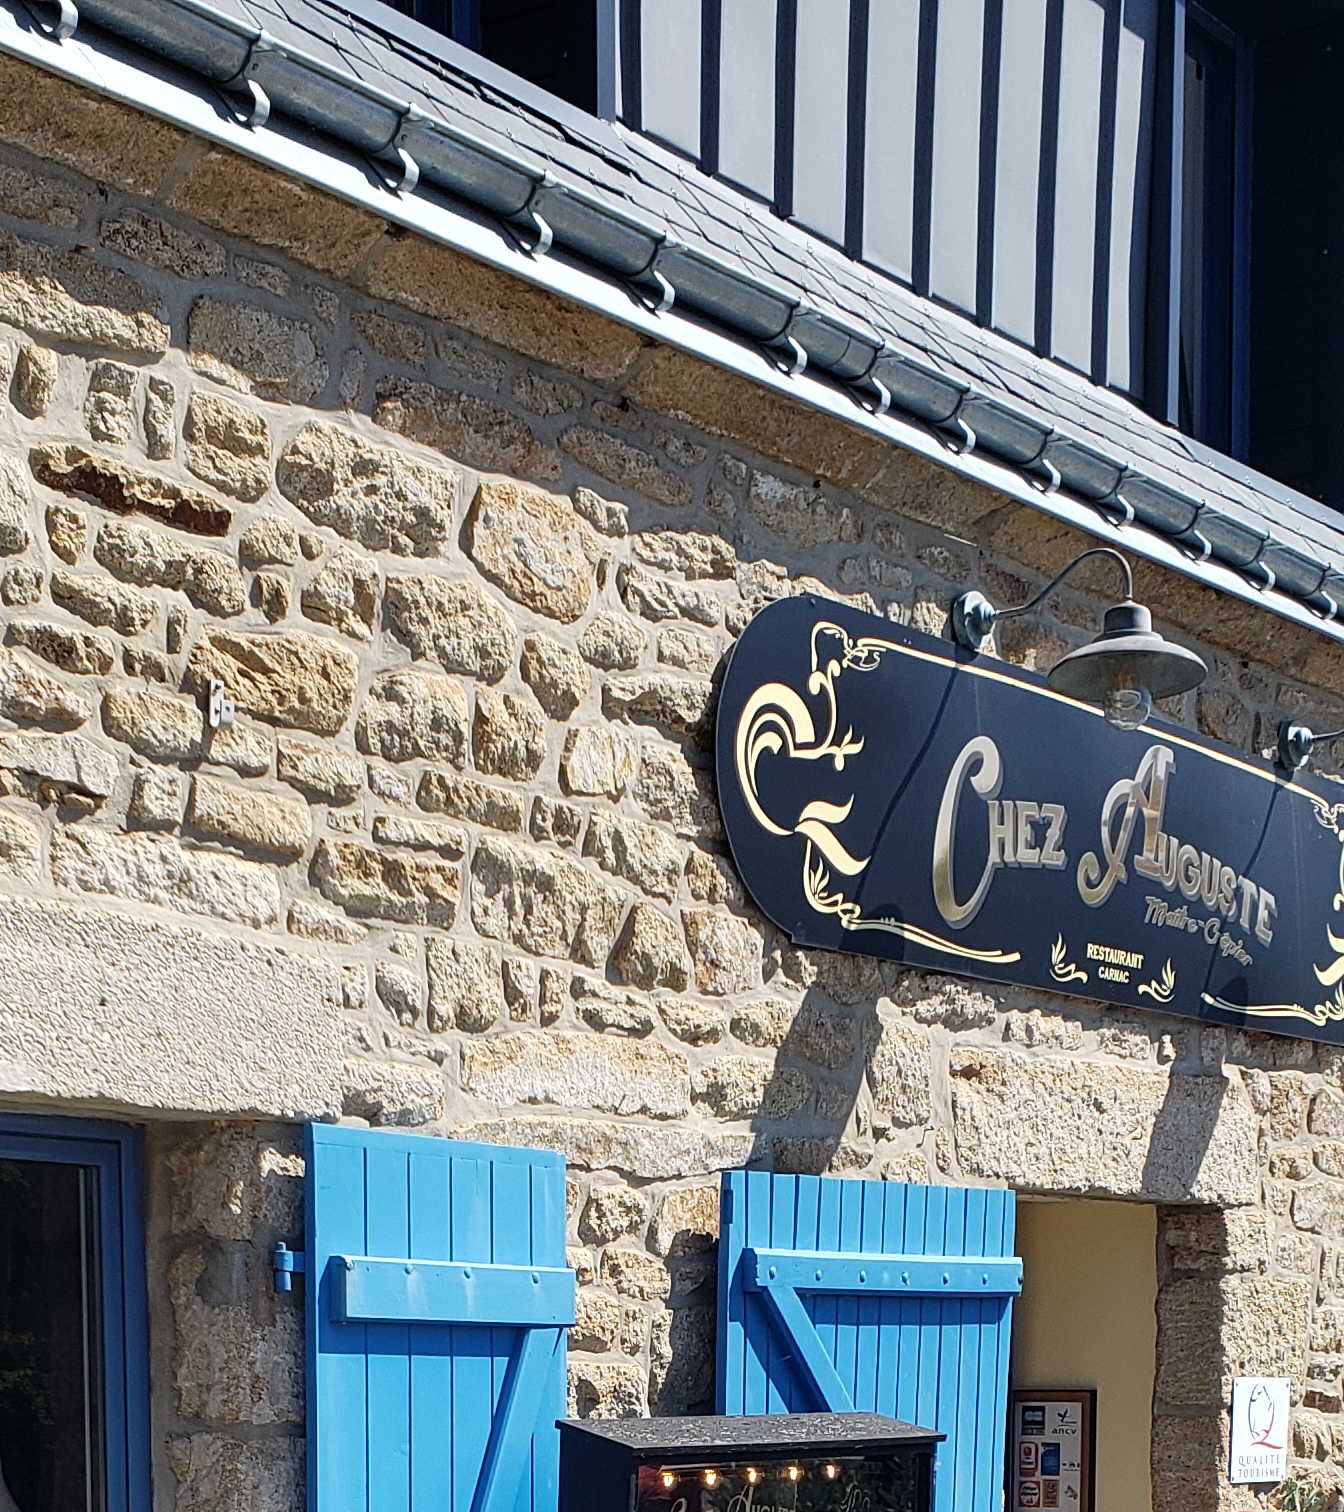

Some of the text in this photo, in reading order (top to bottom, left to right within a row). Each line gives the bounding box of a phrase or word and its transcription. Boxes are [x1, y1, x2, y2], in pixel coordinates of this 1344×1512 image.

[1086, 942, 1145, 970] RESTAURANT
[1098, 966, 1131, 984] CARNAC
[1051, 1427, 1077, 1435] ancv
[1238, 1467, 1280, 1479] TOURISME
